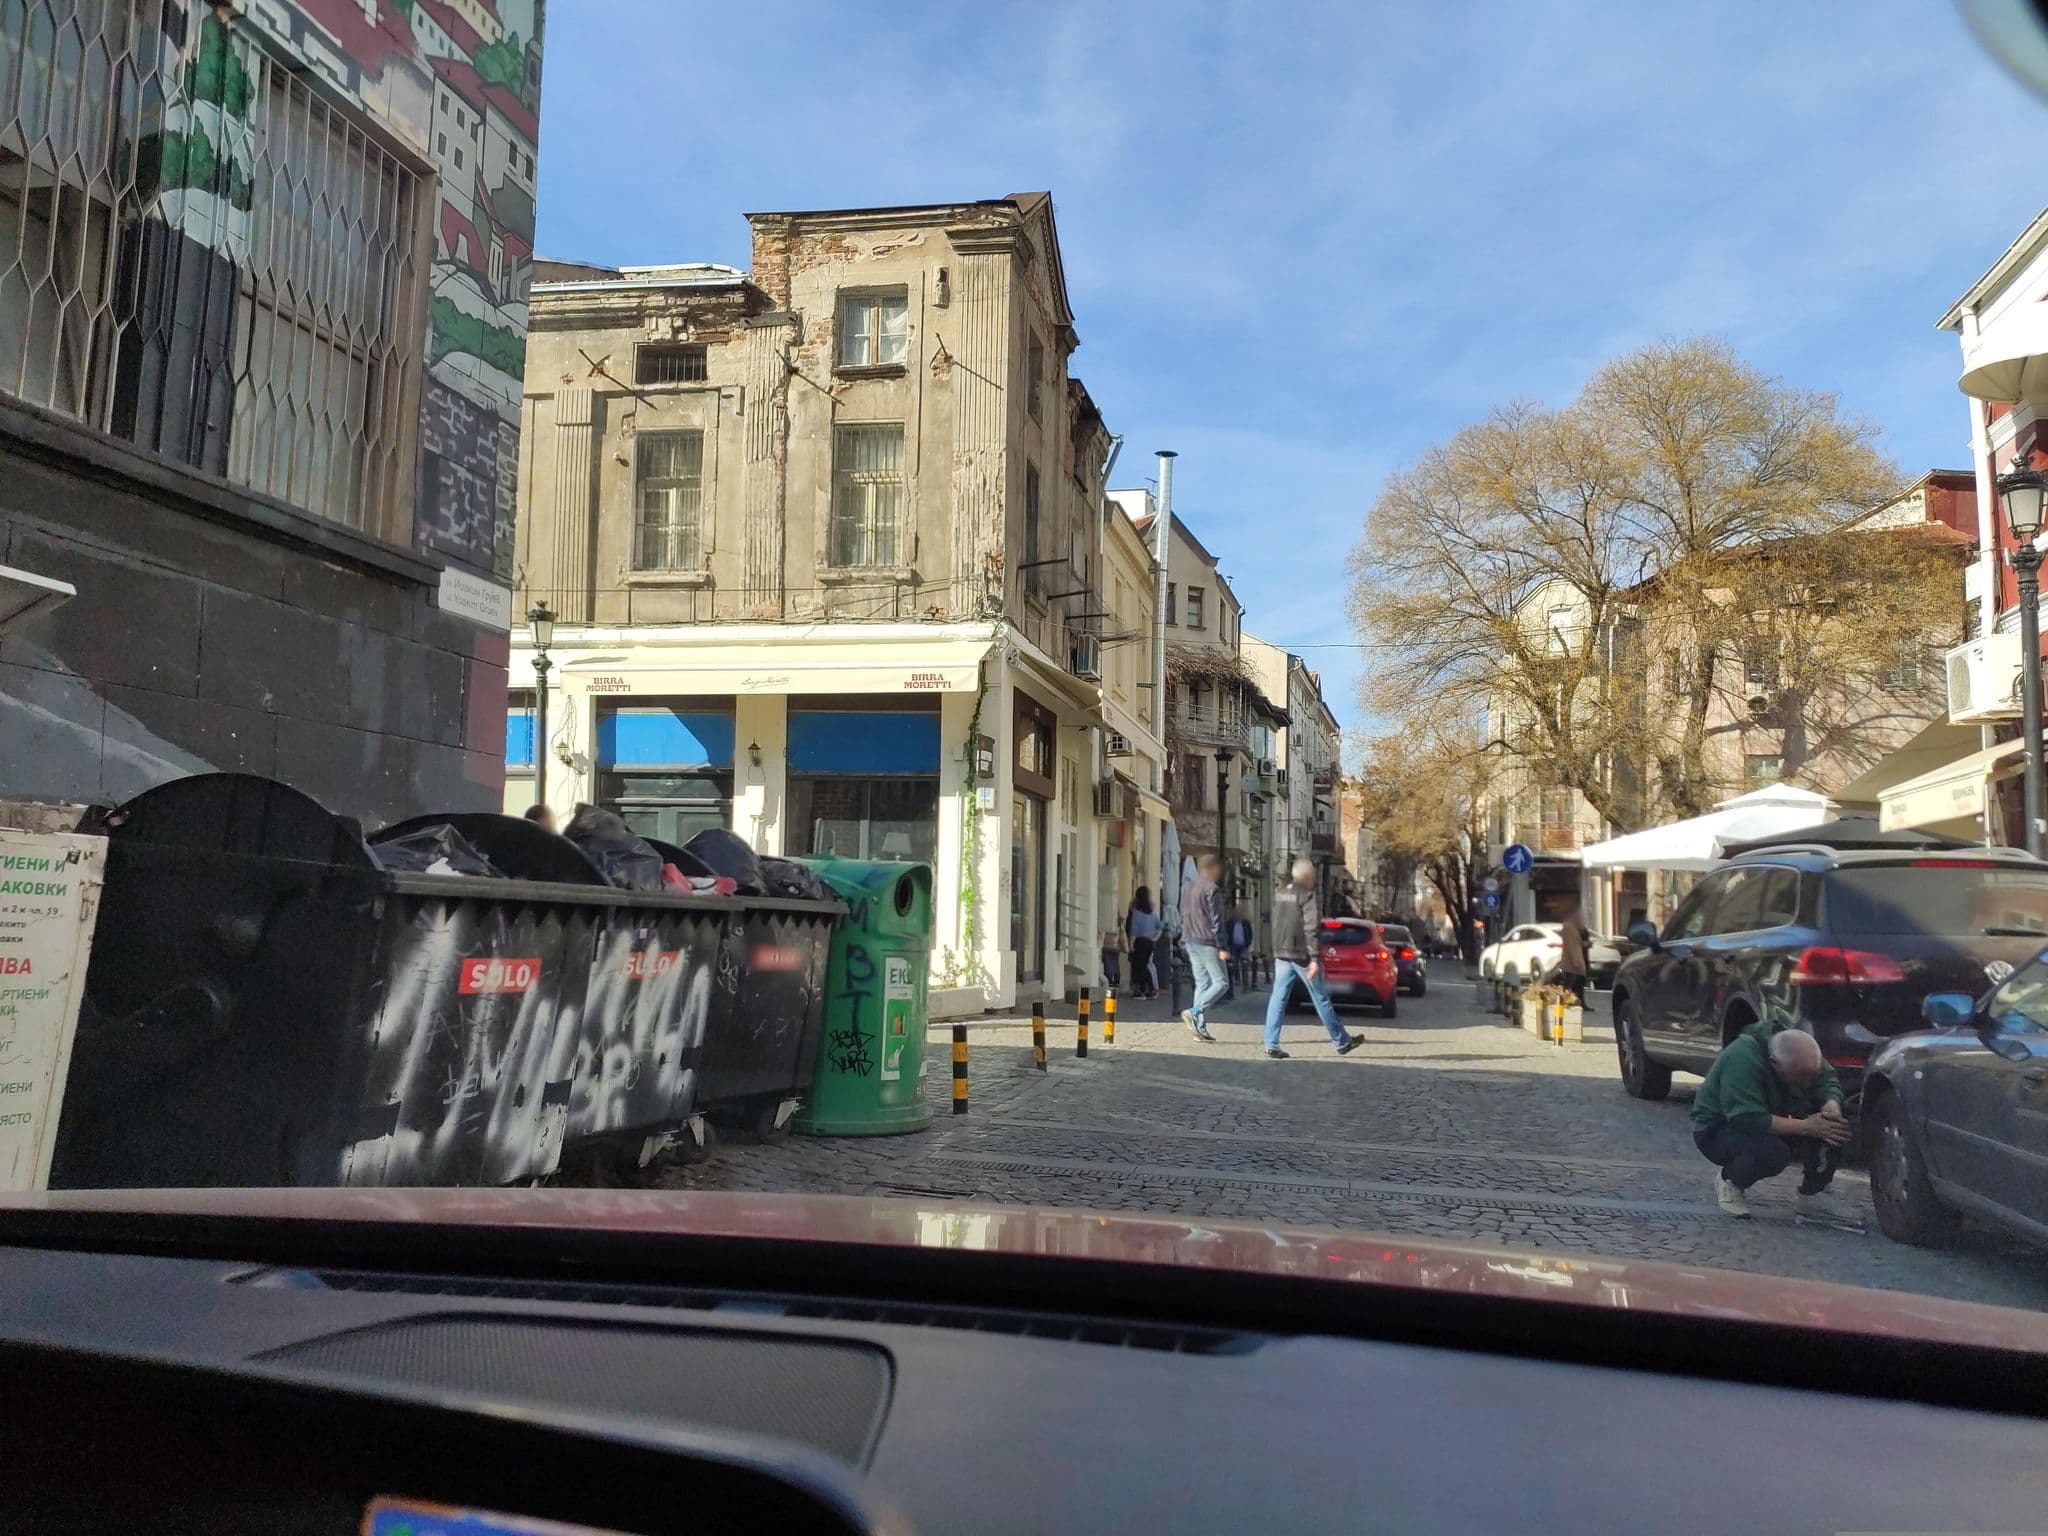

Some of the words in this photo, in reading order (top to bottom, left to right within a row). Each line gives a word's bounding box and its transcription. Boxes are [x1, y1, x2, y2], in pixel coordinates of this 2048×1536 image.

[593, 677, 624, 685] BIRRA
[912, 673, 944, 681] BIRRA
[586, 684, 631, 692] MORETTI
[904, 681, 952, 689] MORETTI
